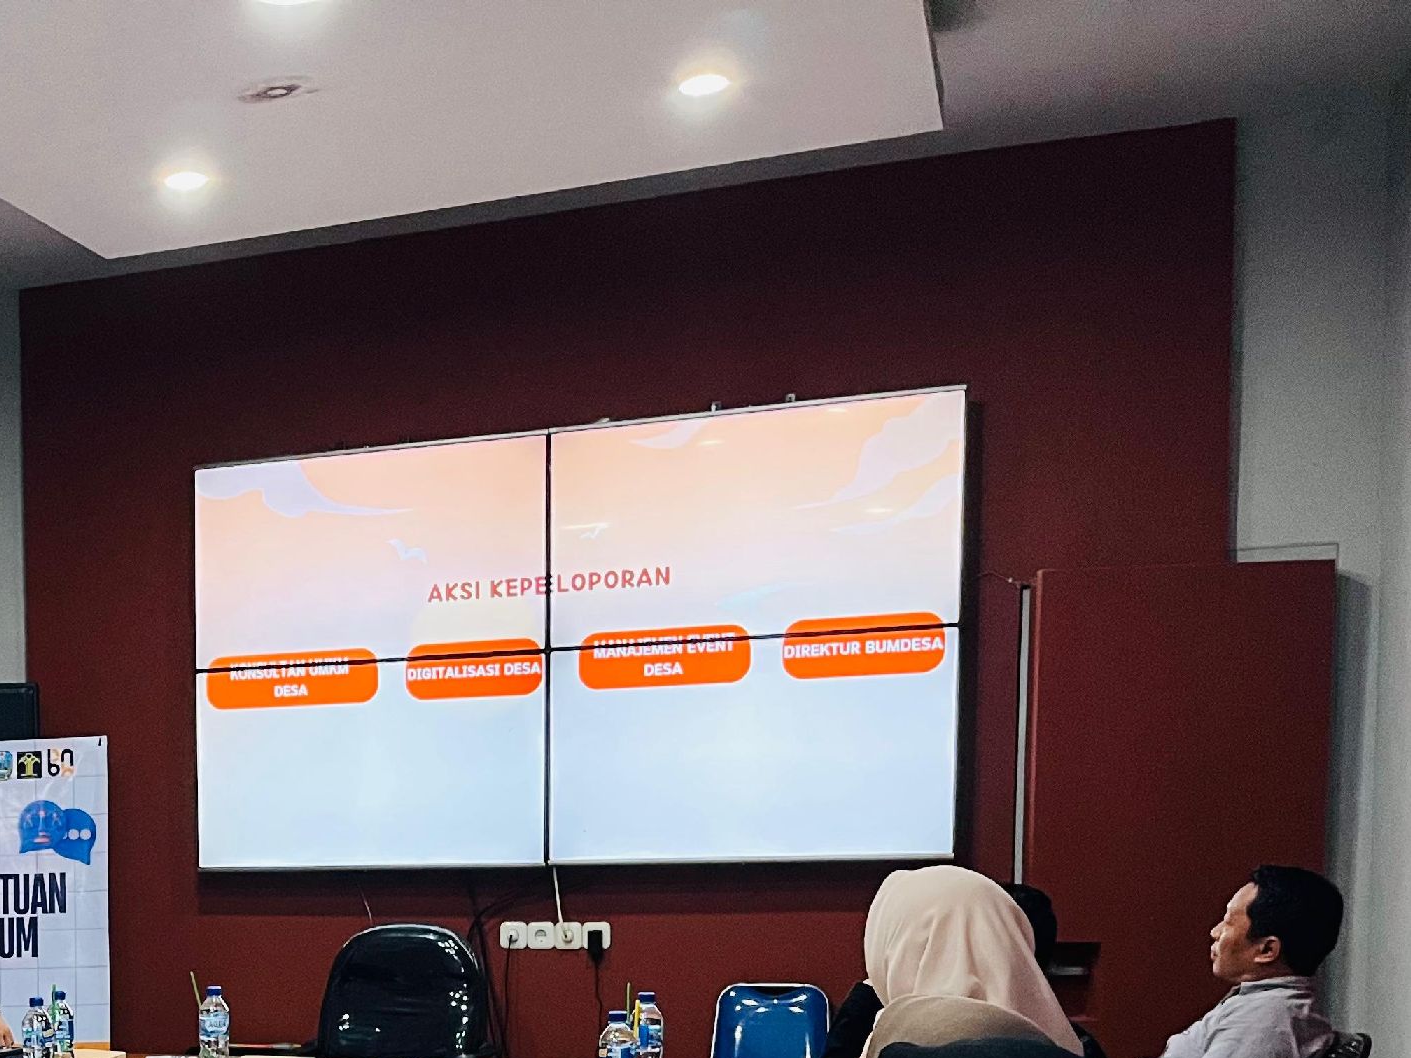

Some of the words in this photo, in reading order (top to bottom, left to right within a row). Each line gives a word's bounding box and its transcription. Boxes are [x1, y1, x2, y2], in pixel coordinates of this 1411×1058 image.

[427, 581, 481, 603] AKSI
[490, 566, 672, 599] KEPELOPORAN
[593, 636, 683, 660] MANAJEMEN
[686, 631, 736, 654] EVENT
[783, 640, 861, 660] DIREKTUR
[864, 636, 944, 655] BUMDESA
[407, 663, 501, 681] DIGITALISASI
[503, 661, 542, 677] DESA
[643, 661, 684, 677] DESA
[273, 682, 309, 698] DESA
